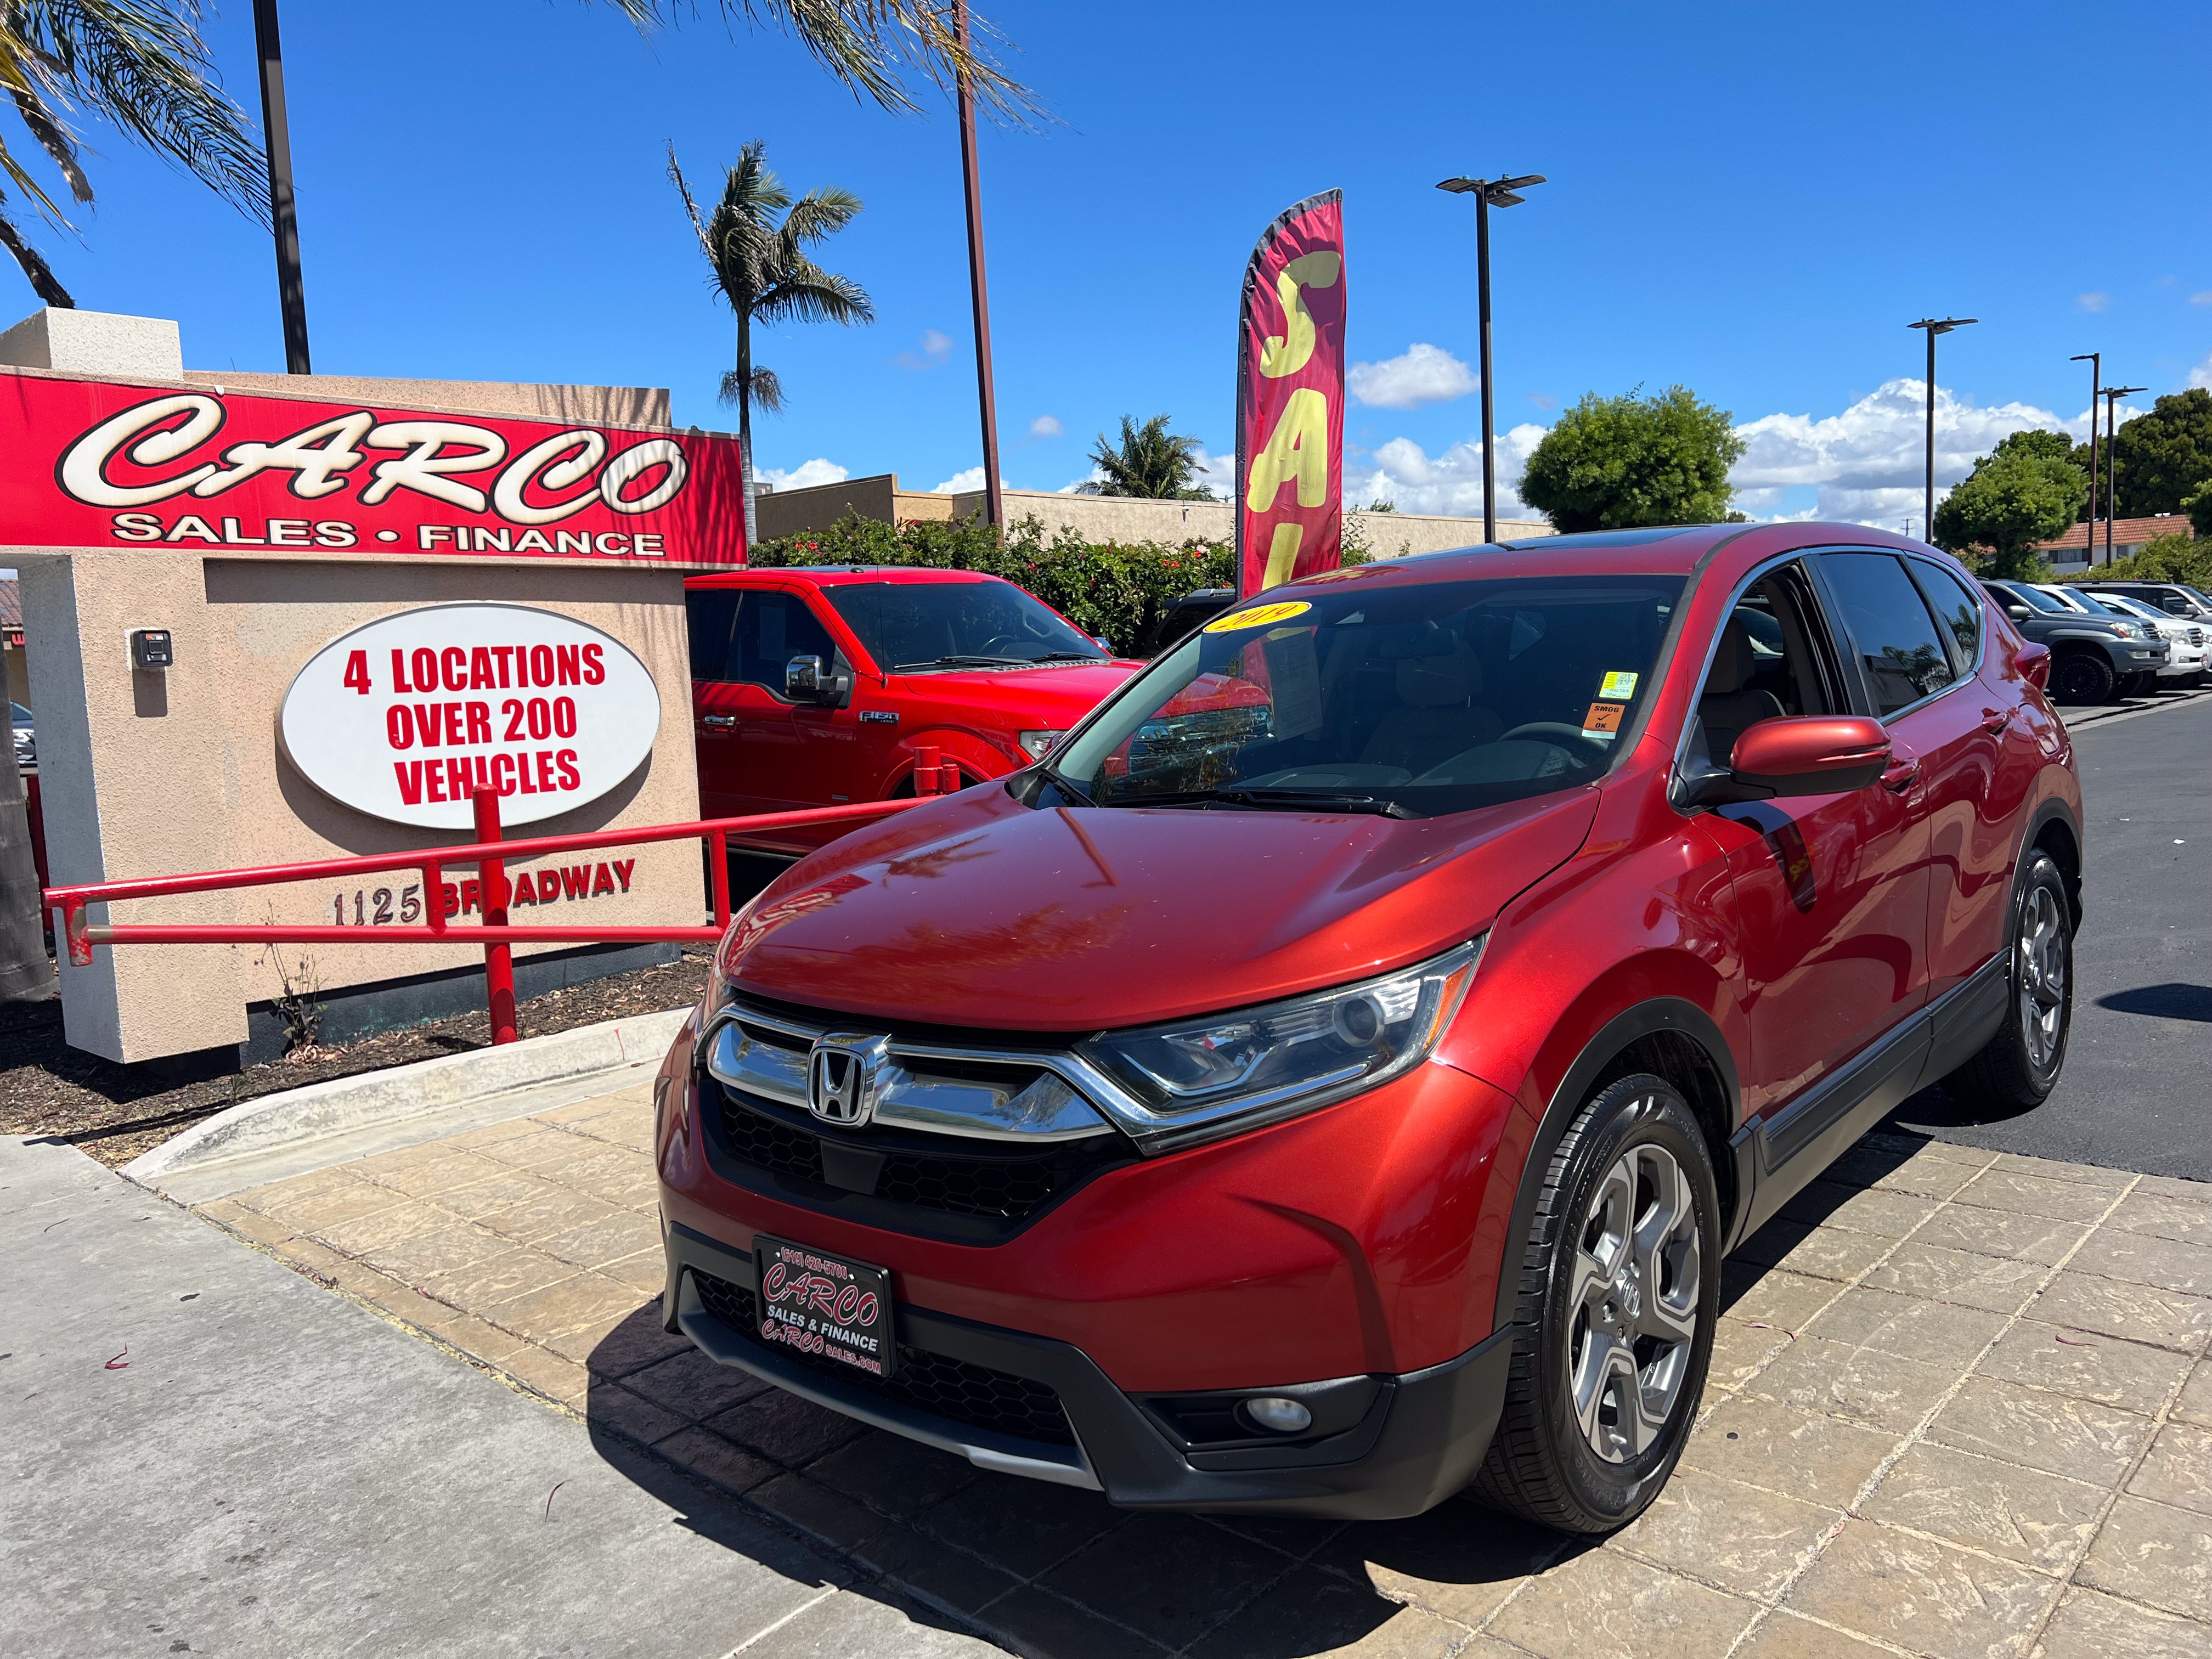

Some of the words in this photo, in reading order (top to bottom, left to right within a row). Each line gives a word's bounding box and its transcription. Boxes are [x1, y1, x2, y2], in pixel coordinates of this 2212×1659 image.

[55, 393, 689, 524] CARCO
[111, 512, 359, 547] SALES
[417, 524, 666, 557] FINANCE
[344, 650, 371, 695] 4
[391, 643, 605, 693] LOCATIONS
[386, 701, 492, 749] OVER
[501, 696, 577, 741] 200
[394, 749, 580, 806] VEHICLES
[334, 884, 421, 926] 1125
[781, 1246, 804, 1267] (619)
[805, 1255, 848, 1280] 420-5700
[763, 1263, 878, 1327] CARCO
[768, 1305, 805, 1327] SALES
[808, 1319, 817, 1331] &
[821, 1322, 878, 1352] FINANCE
